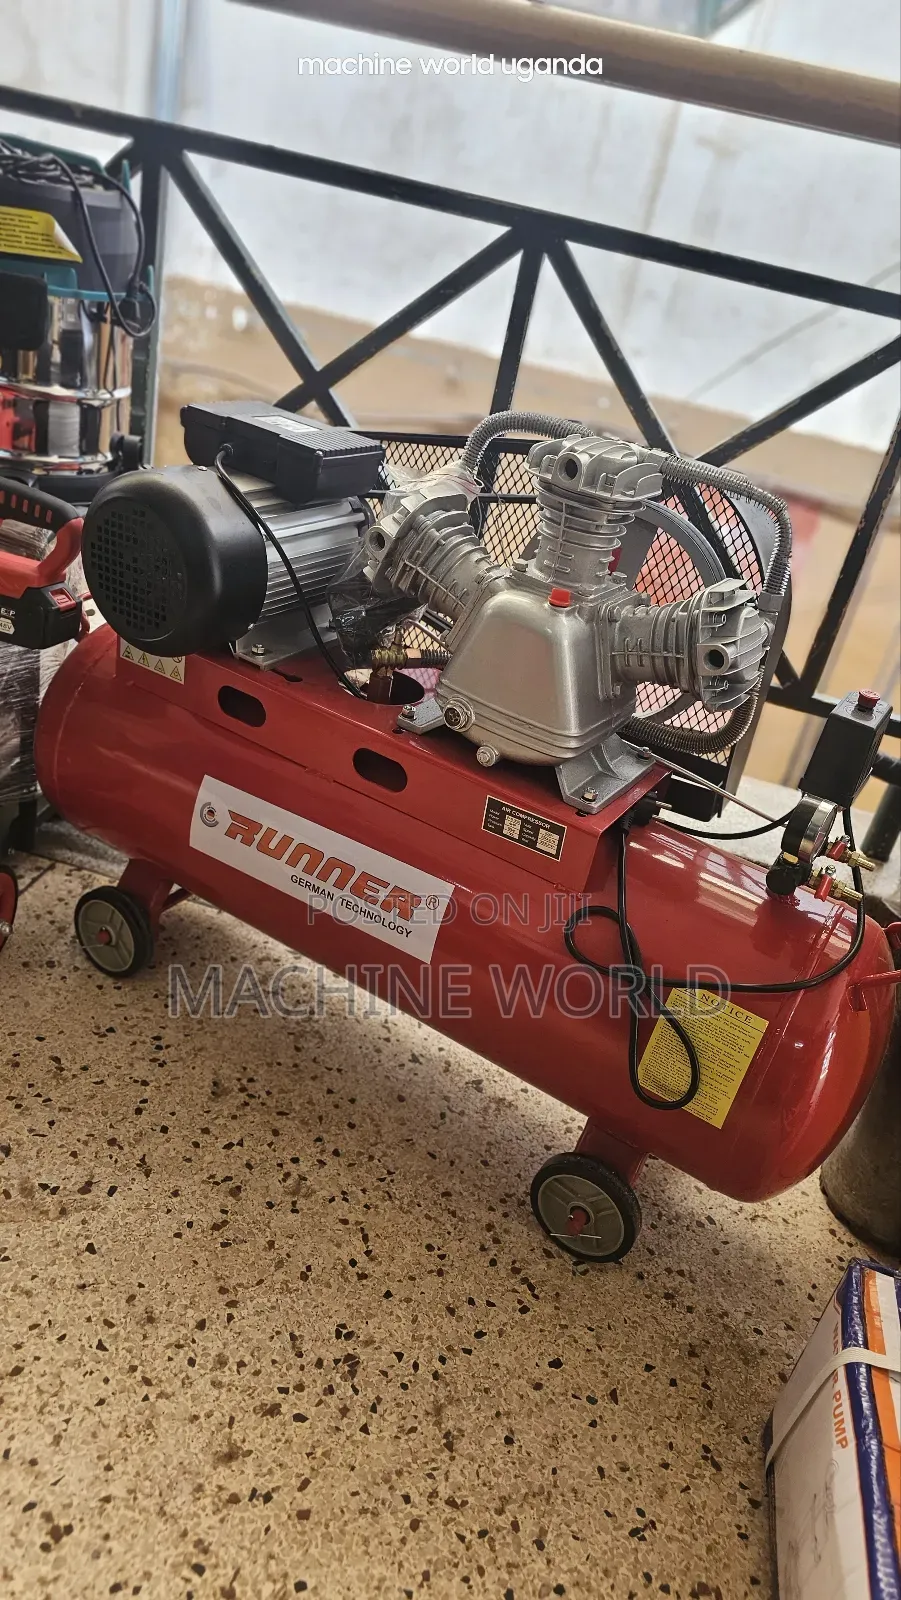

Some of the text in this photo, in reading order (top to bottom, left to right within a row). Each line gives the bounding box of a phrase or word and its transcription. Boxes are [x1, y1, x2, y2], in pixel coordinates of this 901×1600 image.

[224, 809, 423, 922] RUNNER
[290, 874, 413, 938] GERMAN TECHNOLOGY
[700, 993, 753, 1023] NOTICE
[833, 1389, 848, 1448] PUMP
